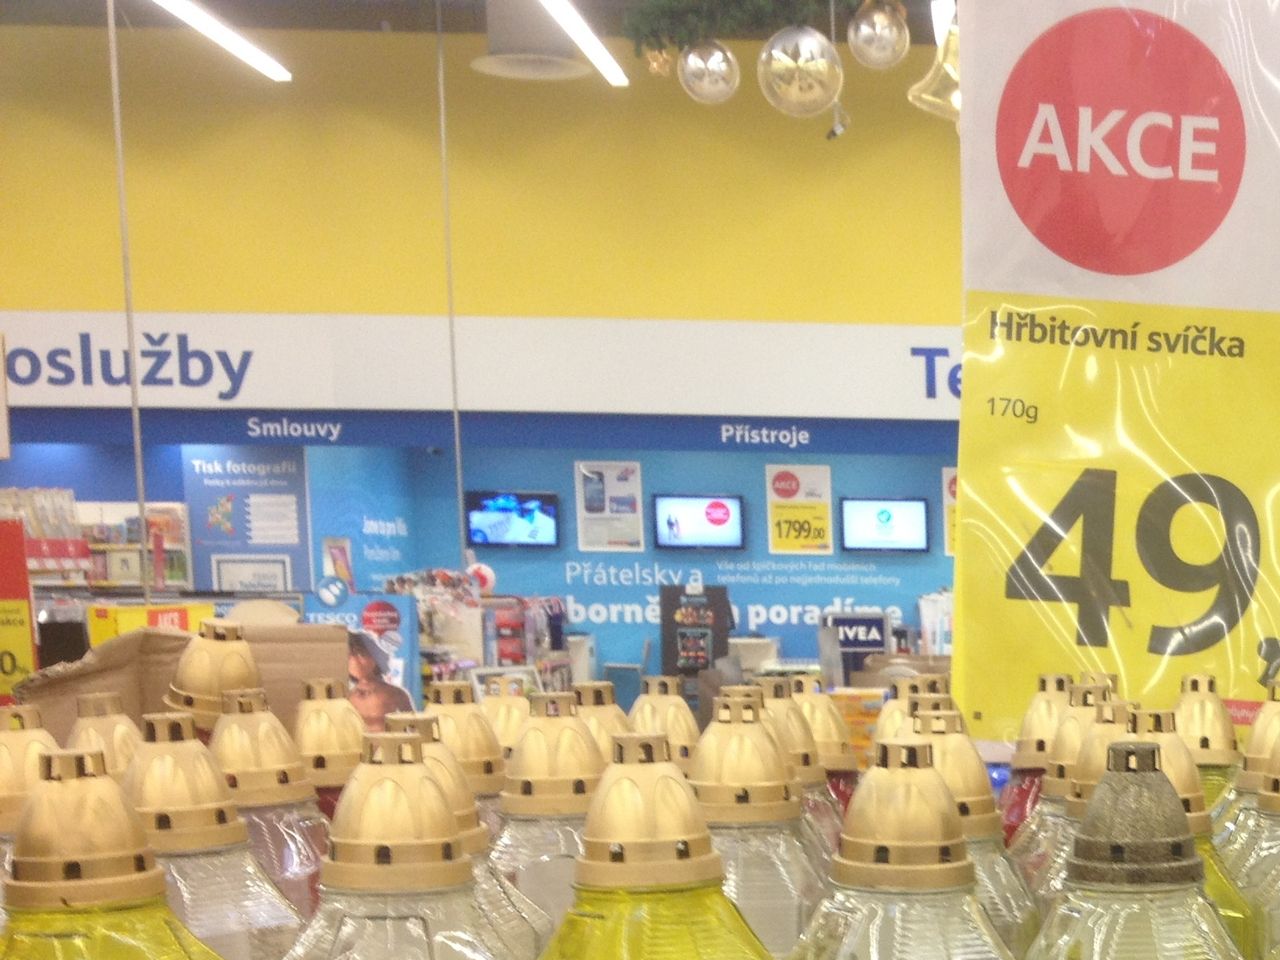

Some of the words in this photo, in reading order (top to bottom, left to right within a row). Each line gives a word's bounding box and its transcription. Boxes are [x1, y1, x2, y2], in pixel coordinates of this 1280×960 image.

[1017, 103, 1220, 184] AKCE
[989, 310, 1138, 352] Hřbitovní
[1147, 325, 1246, 358] svíčka
[5, 332, 254, 400] oslužby
[986, 397, 1039, 424] 170g
[247, 417, 342, 441] Smlouvy
[720, 424, 810, 447] Přístroje
[191, 459, 223, 474] Tisk
[565, 561, 683, 586] Přátelsky
[688, 568, 704, 584] a
[836, 625, 882, 642] IVEA
